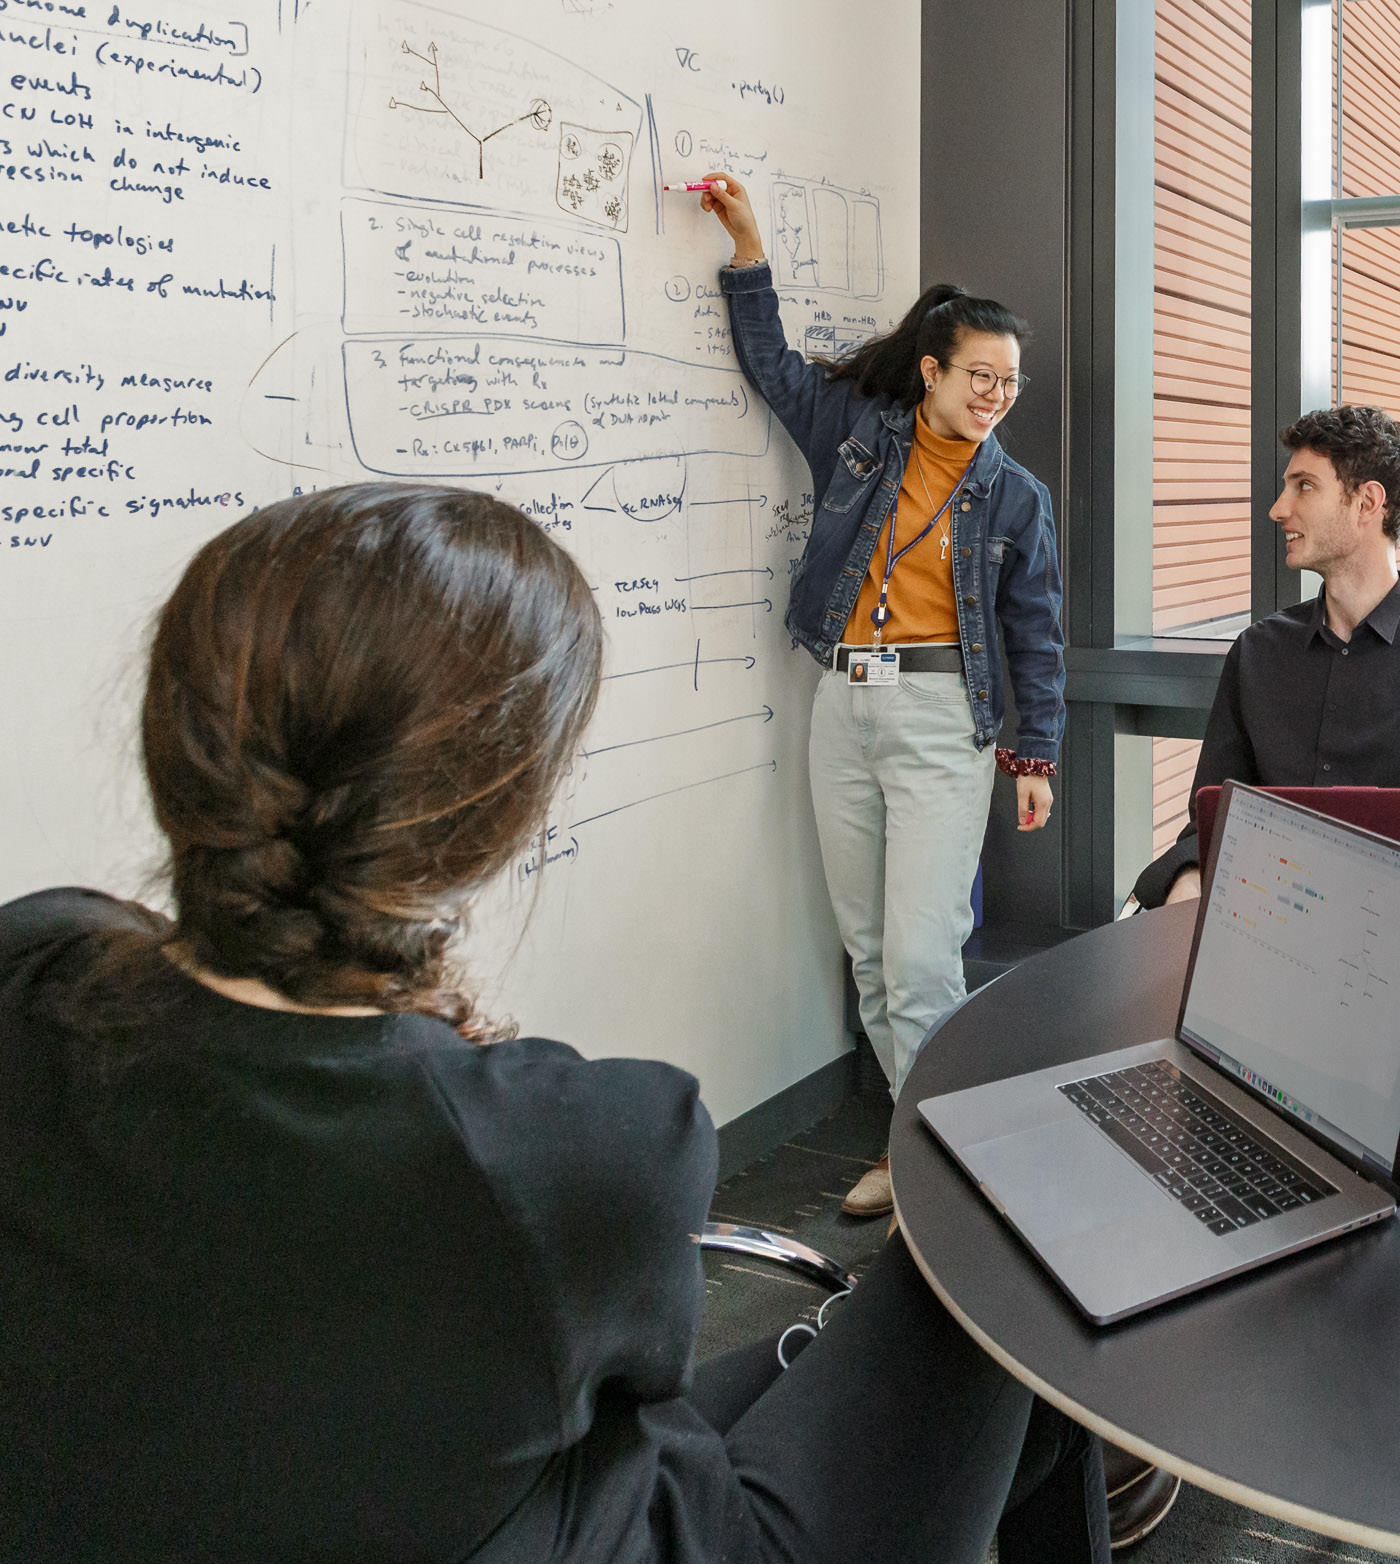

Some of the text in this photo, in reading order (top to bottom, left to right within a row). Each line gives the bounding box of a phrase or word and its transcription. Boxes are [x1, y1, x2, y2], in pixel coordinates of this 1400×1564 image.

[11, 72, 91, 99] events
[51, 109, 93, 129] LOH
[115, 119, 133, 135] in
[146, 121, 241, 153] intergenic
[27, 139, 95, 162] which
[113, 148, 137, 168] do
[153, 157, 190, 176] not
[201, 164, 271, 189] induce
[110, 176, 184, 203] change
[64, 222, 173, 255] topologies
[454, 225, 481, 241] cell
[528, 260, 596, 276] processes
[78, 267, 134, 291] rates
[146, 274, 173, 298] of
[182, 279, 276, 301] mutation
[5, 362, 212, 392] diversity measures
[37, 404, 80, 425] cell
[101, 407, 212, 433] proportion
[61, 435, 108, 456] total
[52, 460, 136, 482] specific
[2, 488, 244, 524] specific signatures
